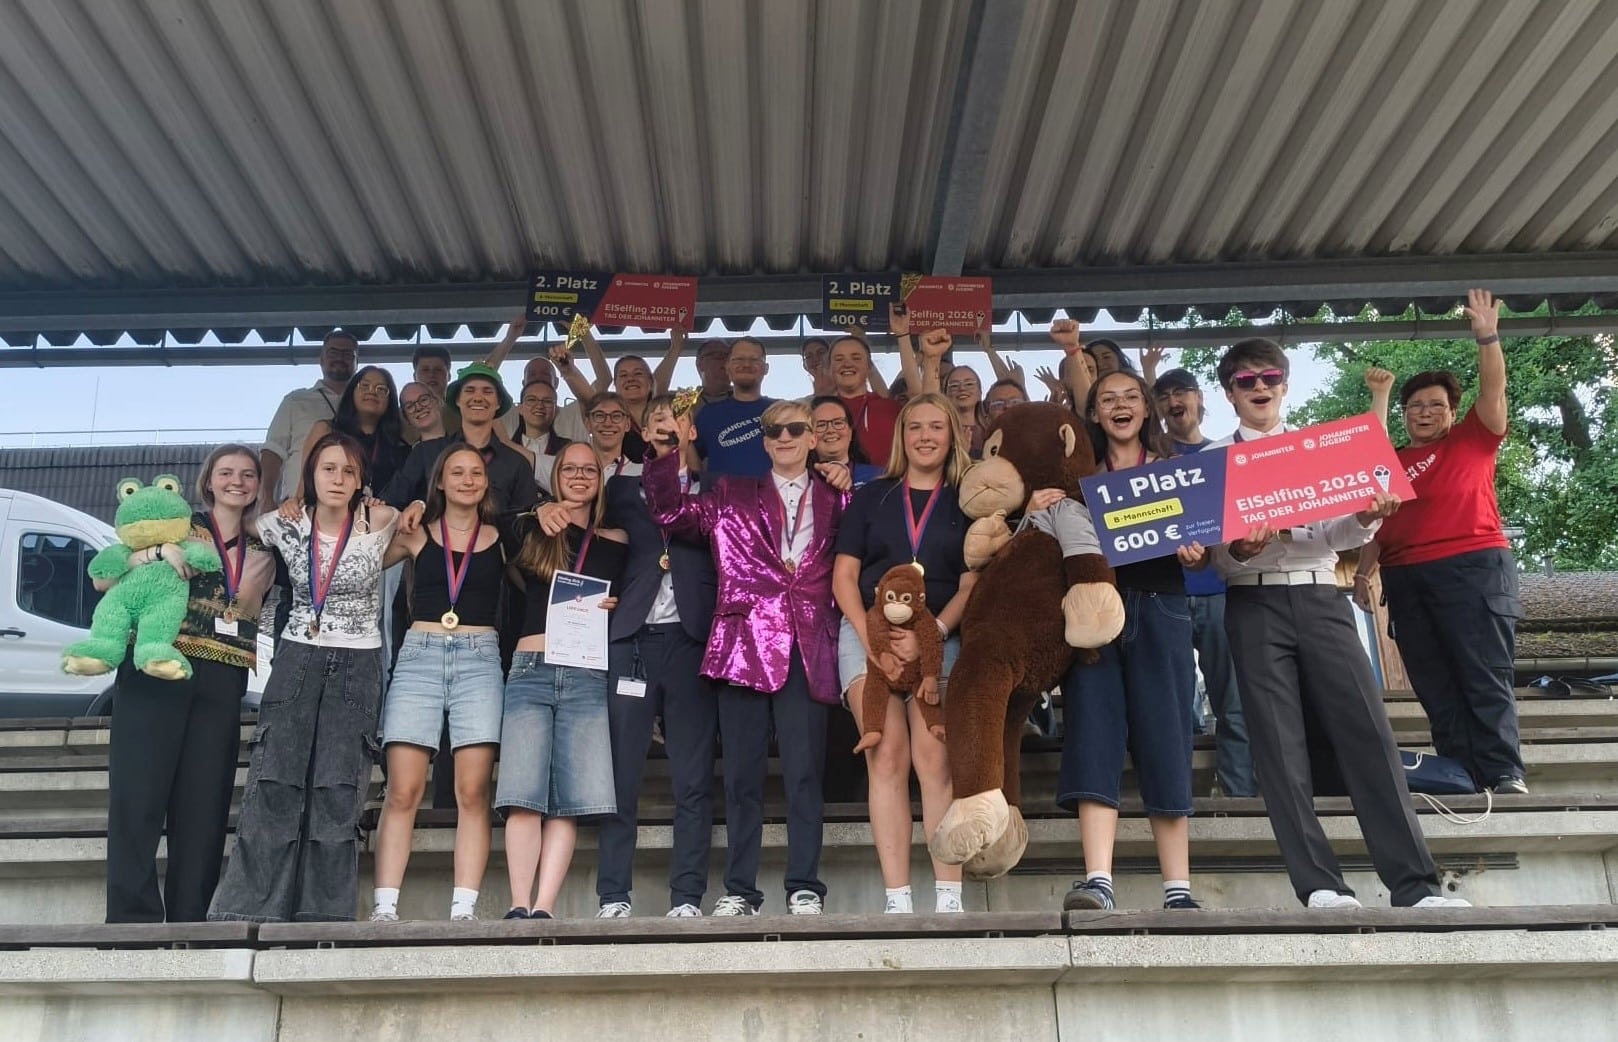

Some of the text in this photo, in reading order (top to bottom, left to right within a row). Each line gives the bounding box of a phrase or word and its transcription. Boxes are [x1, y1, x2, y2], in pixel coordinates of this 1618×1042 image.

[536, 275, 598, 290] 2. Platz
[829, 281, 892, 296] 2. Platz
[533, 305, 573, 316] 400 €
[650, 306, 677, 315] 2026
[911, 310, 974, 320] Selfing 2026
[830, 314, 856, 325] 400
[859, 315, 869, 325] €
[1319, 424, 1370, 441] JOHANNITER
[1319, 435, 1351, 448] JUGEND
[1251, 445, 1297, 460] JOHANNITER
[1096, 467, 1206, 504] 1. Platz
[1319, 471, 1370, 493] 2026
[1241, 486, 1376, 524] TAG DER JOHANNITER
[1113, 504, 1174, 523] B-Mannschaft
[1113, 524, 1182, 552] 600 €
